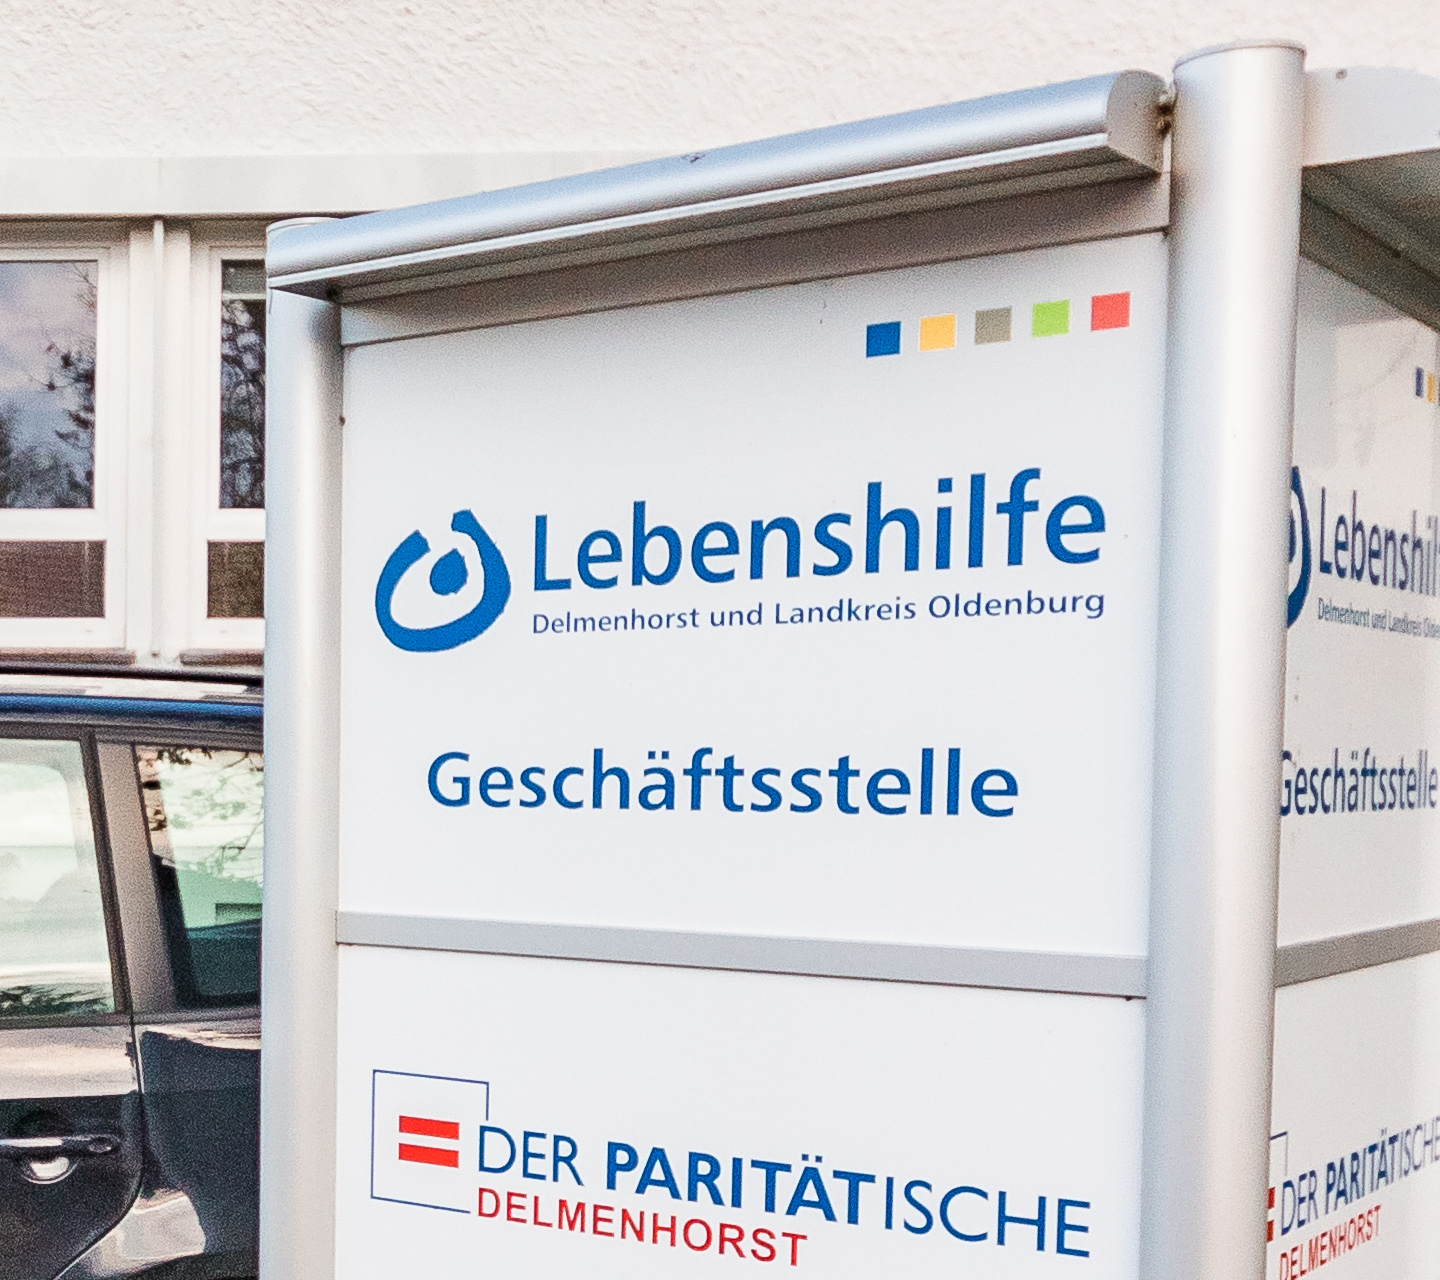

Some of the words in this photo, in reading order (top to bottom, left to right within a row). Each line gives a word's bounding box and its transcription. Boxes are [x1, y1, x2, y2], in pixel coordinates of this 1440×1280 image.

[532, 467, 1107, 593] Lebenshilfe
[532, 608, 700, 634] Delmenhorst
[710, 602, 763, 626] und
[775, 596, 917, 625] Landkreis
[928, 590, 1105, 620] Oldenburg
[426, 746, 1020, 818] Geschäftsstelle
[477, 1124, 584, 1186] DER
[605, 1140, 1091, 1258] PARITÄTISCHE
[1281, 1169, 1318, 1236] DER
[1325, 1116, 1440, 1214] PARITÄTISCHE
[477, 1186, 808, 1267] DELMENHORST
